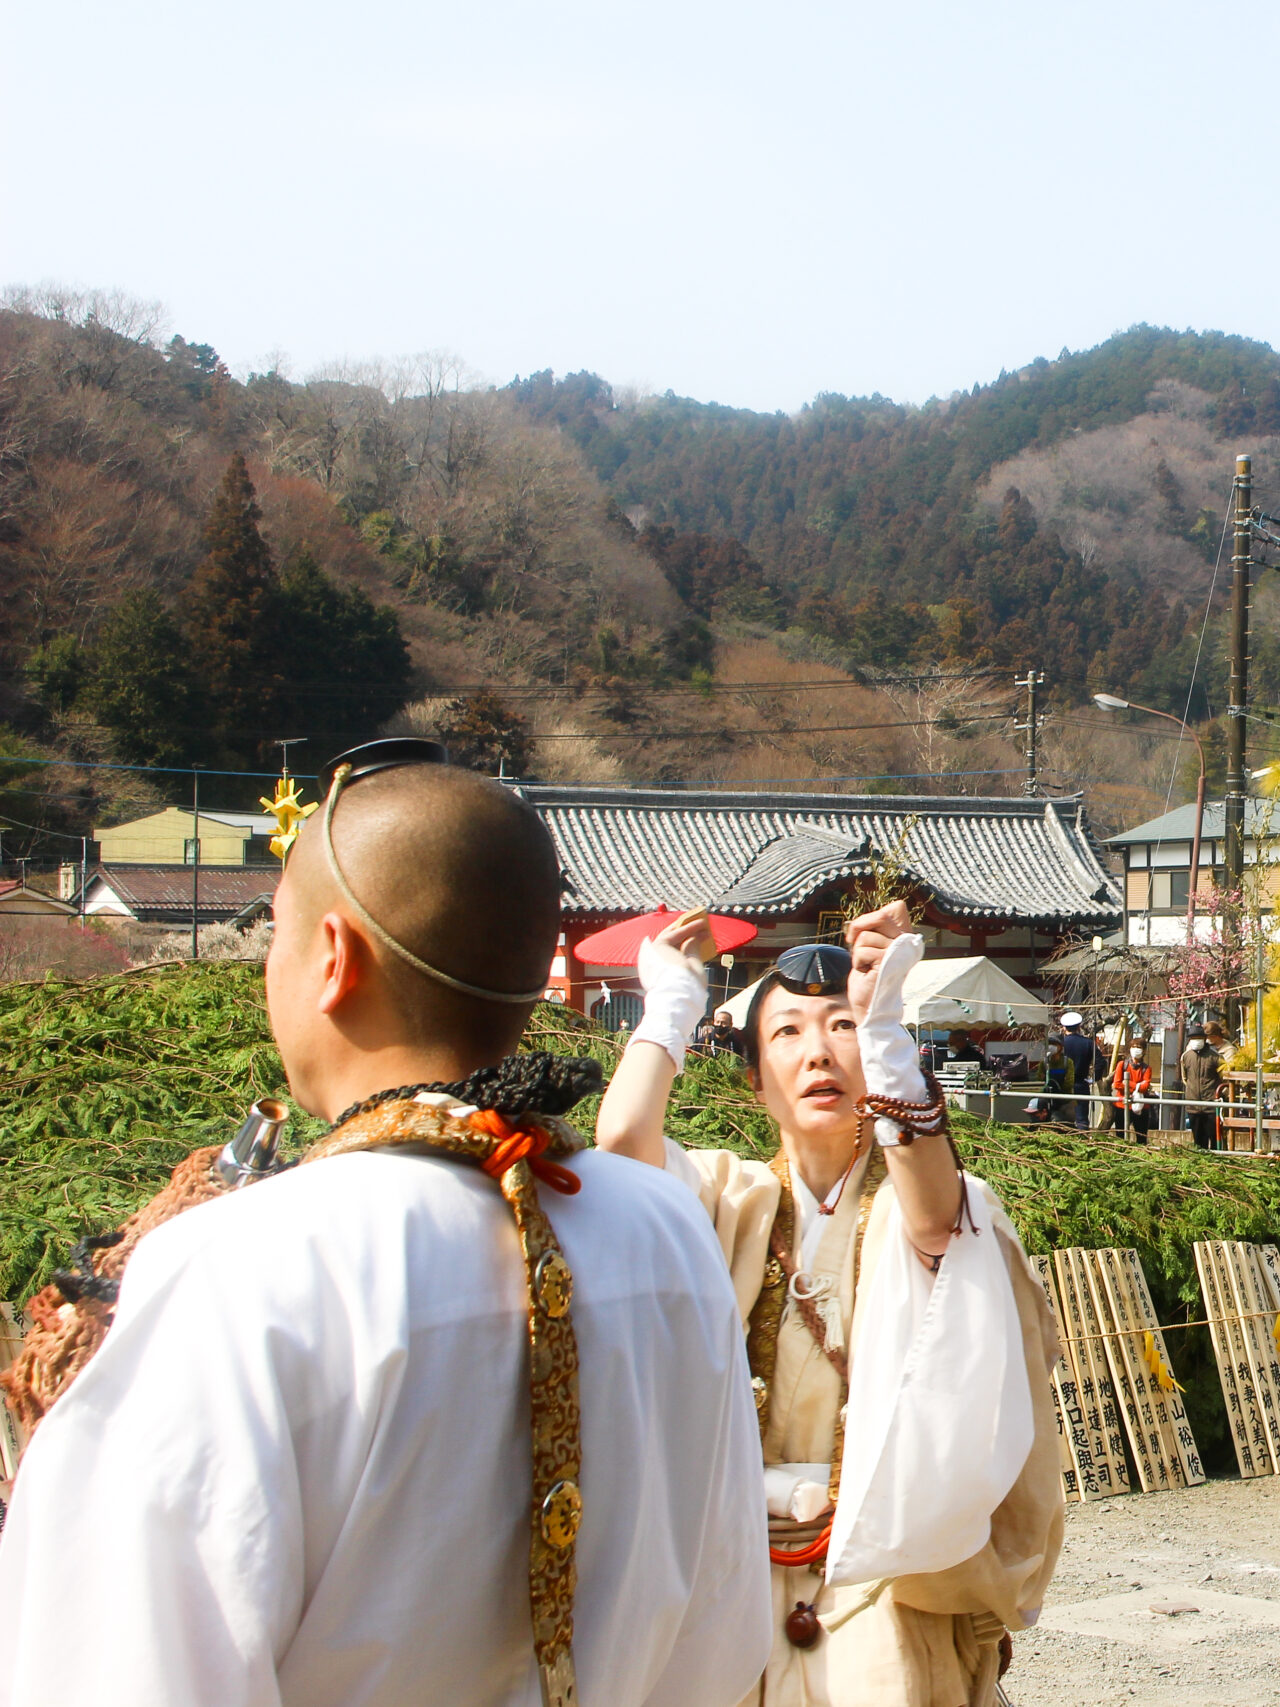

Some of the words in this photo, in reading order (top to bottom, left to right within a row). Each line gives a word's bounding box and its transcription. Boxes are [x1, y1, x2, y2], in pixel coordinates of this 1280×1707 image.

[1238, 1361, 1269, 1467] 我妻久美子
